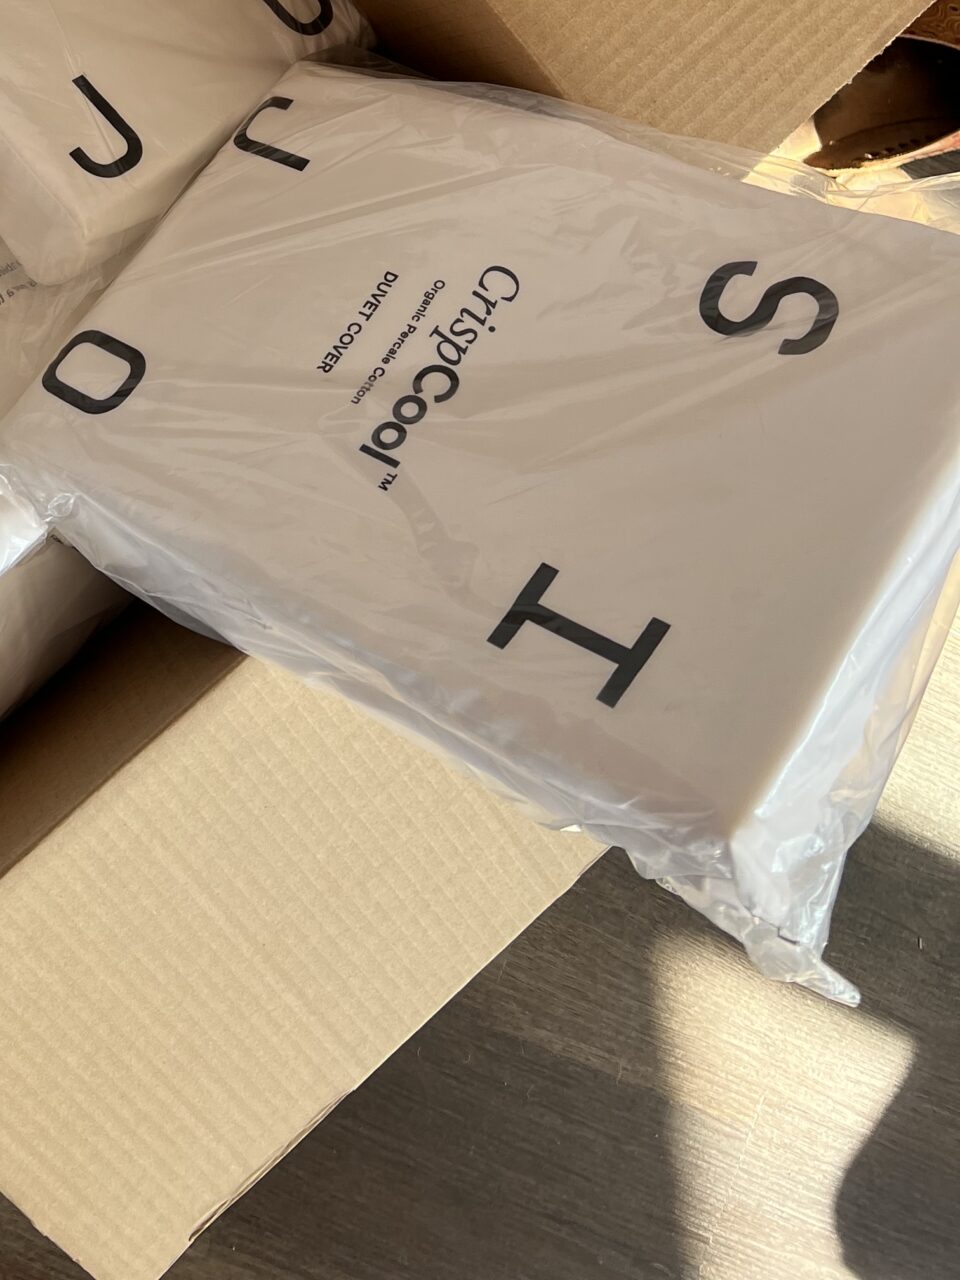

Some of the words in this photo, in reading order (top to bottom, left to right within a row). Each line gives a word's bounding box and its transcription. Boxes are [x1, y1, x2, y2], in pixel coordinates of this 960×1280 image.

[69, 75, 142, 178] J
[233, 96, 310, 172] J
[358, 271, 399, 322] DUVET
[411, 279, 446, 323] Organic
[699, 261, 839, 355] S
[42, 330, 146, 414] O
[317, 322, 362, 374] COVER
[381, 323, 417, 365] Percale
[350, 366, 386, 405] Cotton
[487, 563, 671, 708] I
